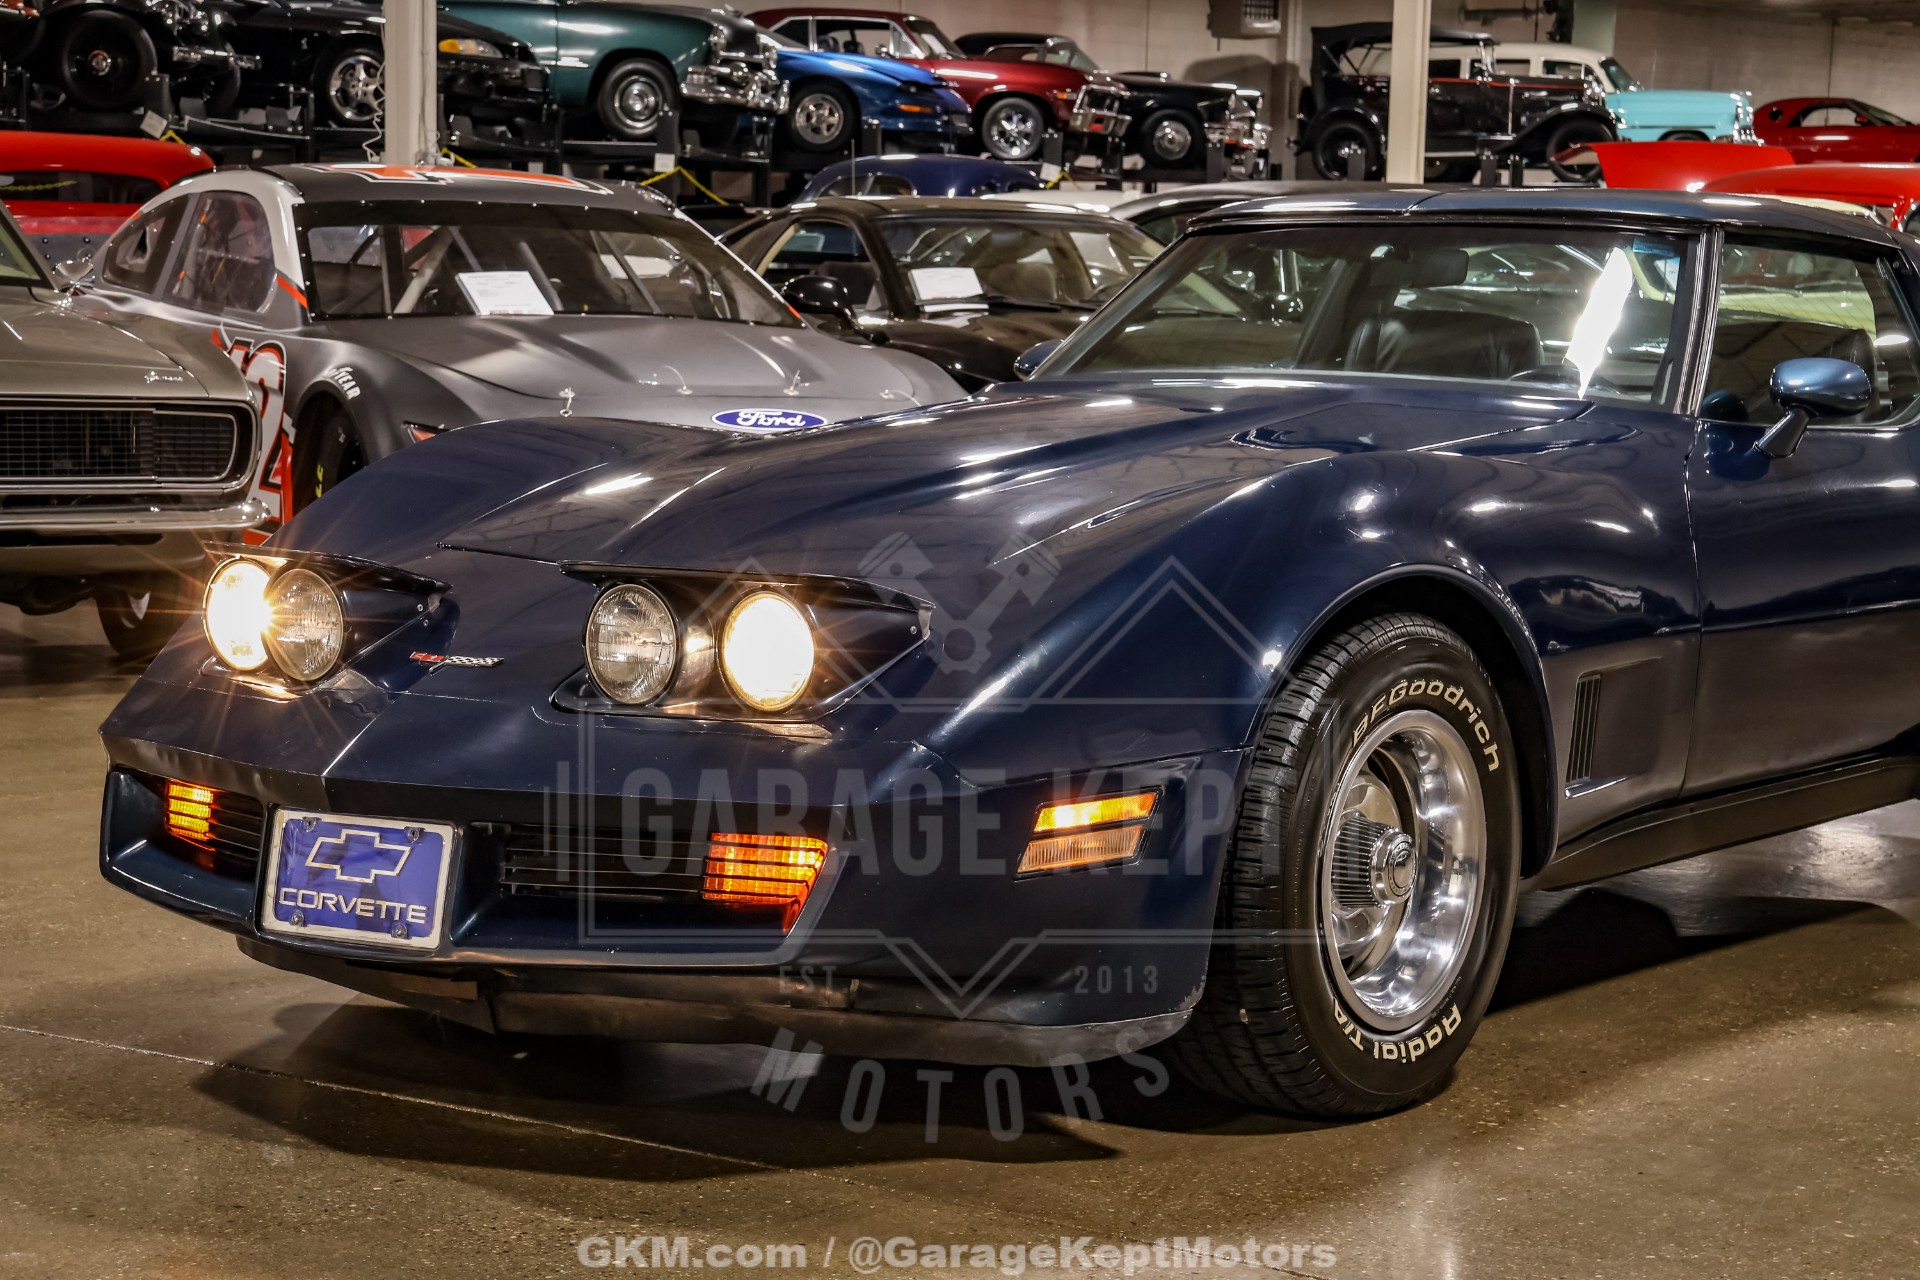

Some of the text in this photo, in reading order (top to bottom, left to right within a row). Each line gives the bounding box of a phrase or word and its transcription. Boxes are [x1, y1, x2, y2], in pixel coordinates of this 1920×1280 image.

[736, 411, 806, 427] Ford
[1353, 679, 1500, 772] BFGoodrich
[279, 887, 428, 924] CORVETTE
[1333, 998, 1462, 1063] Radial T/A
